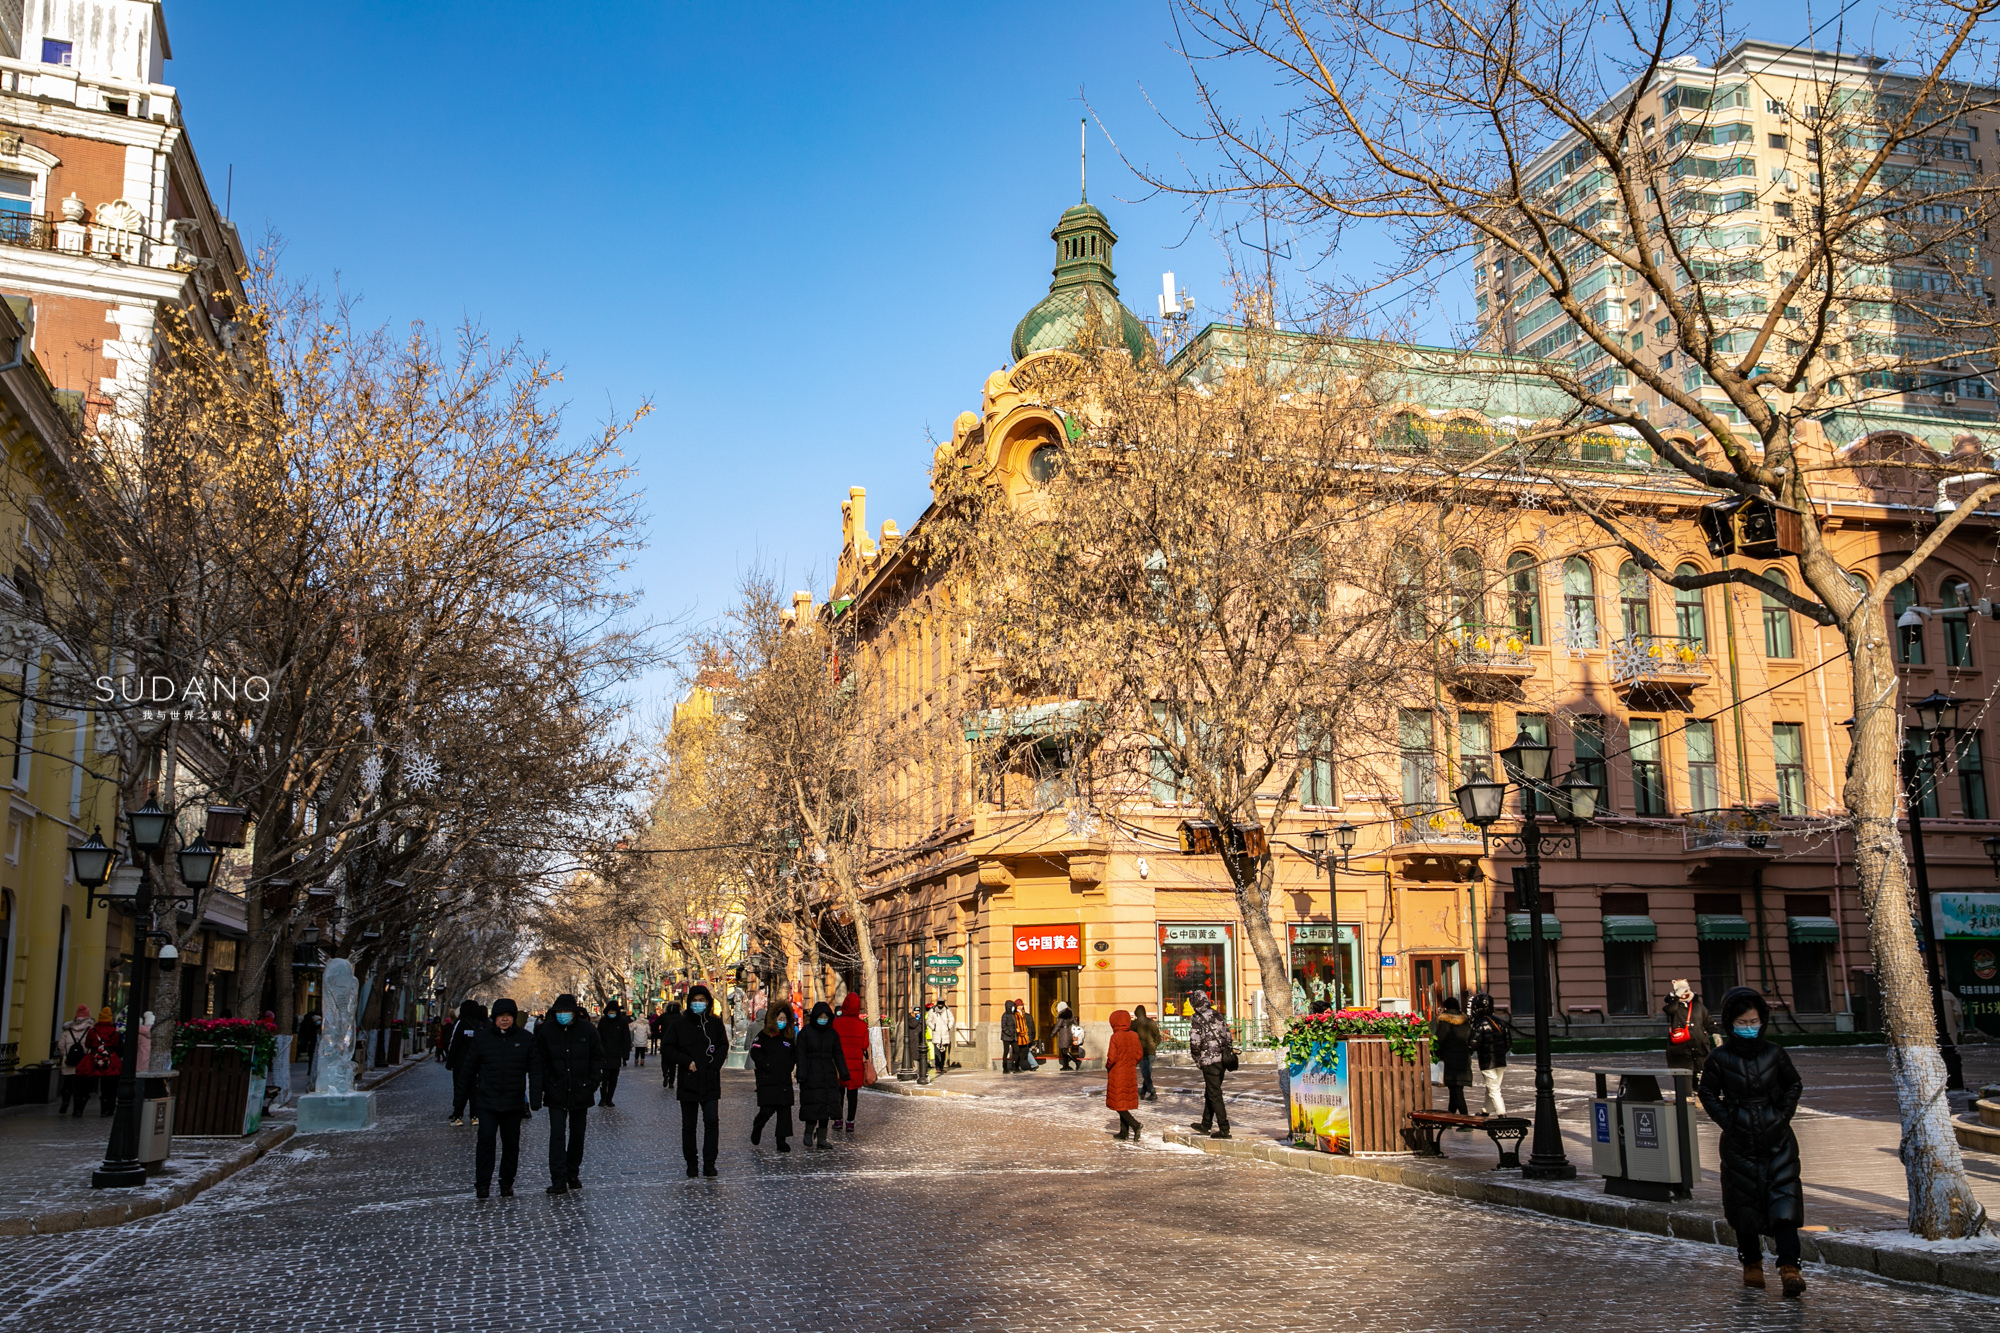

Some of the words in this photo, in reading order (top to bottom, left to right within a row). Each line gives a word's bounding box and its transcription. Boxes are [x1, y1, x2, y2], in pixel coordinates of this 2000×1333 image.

[1179, 929, 1217, 939] 中国黄金
[1028, 935, 1078, 951] 中国黄金
[1173, 1028, 1191, 1036] Chi
